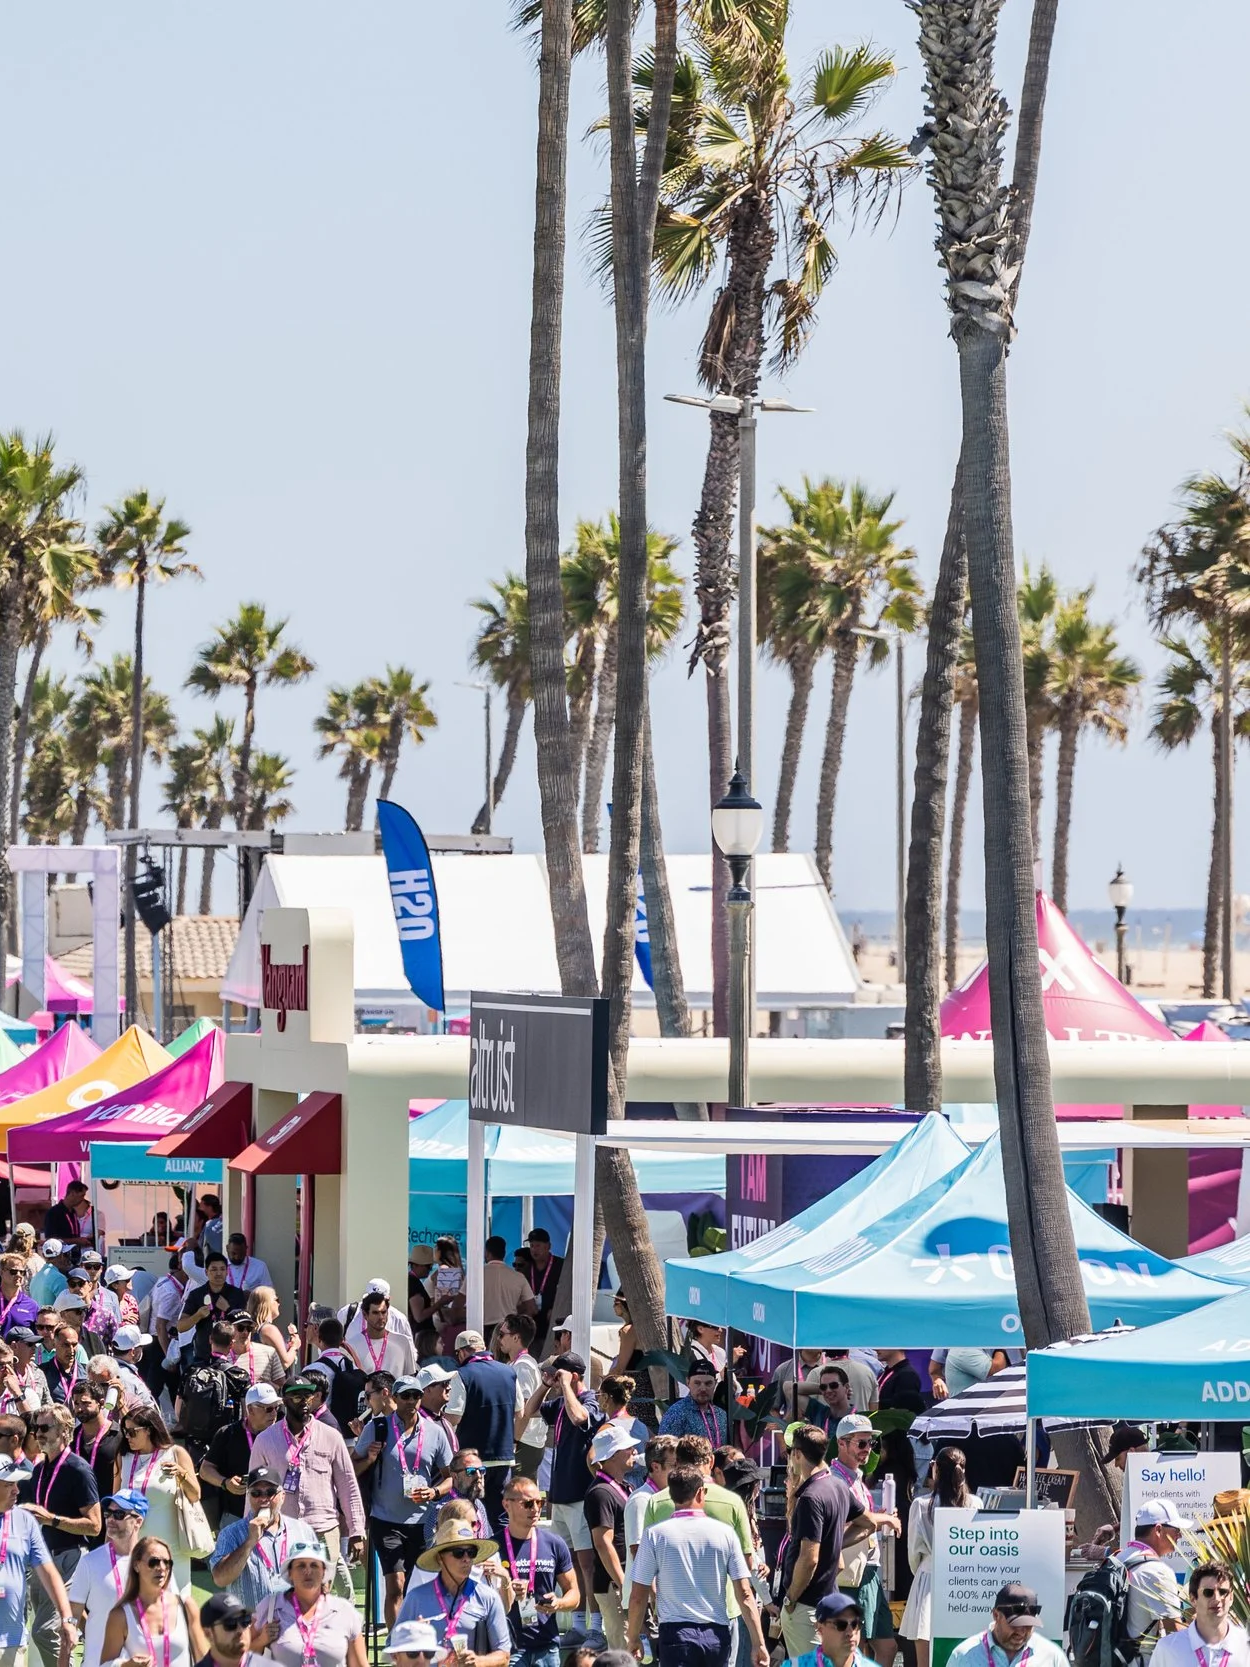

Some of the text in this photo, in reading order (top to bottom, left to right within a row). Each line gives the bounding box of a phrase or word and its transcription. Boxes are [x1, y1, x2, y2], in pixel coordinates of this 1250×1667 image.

[261, 944, 309, 1032] Vanguard
[470, 1018, 516, 1113] altruist
[165, 1159, 204, 1173] ALLIANZ
[689, 1286, 700, 1306] ORION
[753, 1302, 765, 1323] ORION
[1048, 1474, 1066, 1486] CREAM
[1141, 1468, 1205, 1484] Say hello!
[1142, 1489, 1201, 1499] Help clients with
[949, 1526, 1019, 1542] Step into
[949, 1542, 1019, 1556] our oasis
[948, 1564, 1020, 1575] Learn how your
[948, 1577, 979, 1586] clients
[948, 1590, 979, 1600] 4.00%
